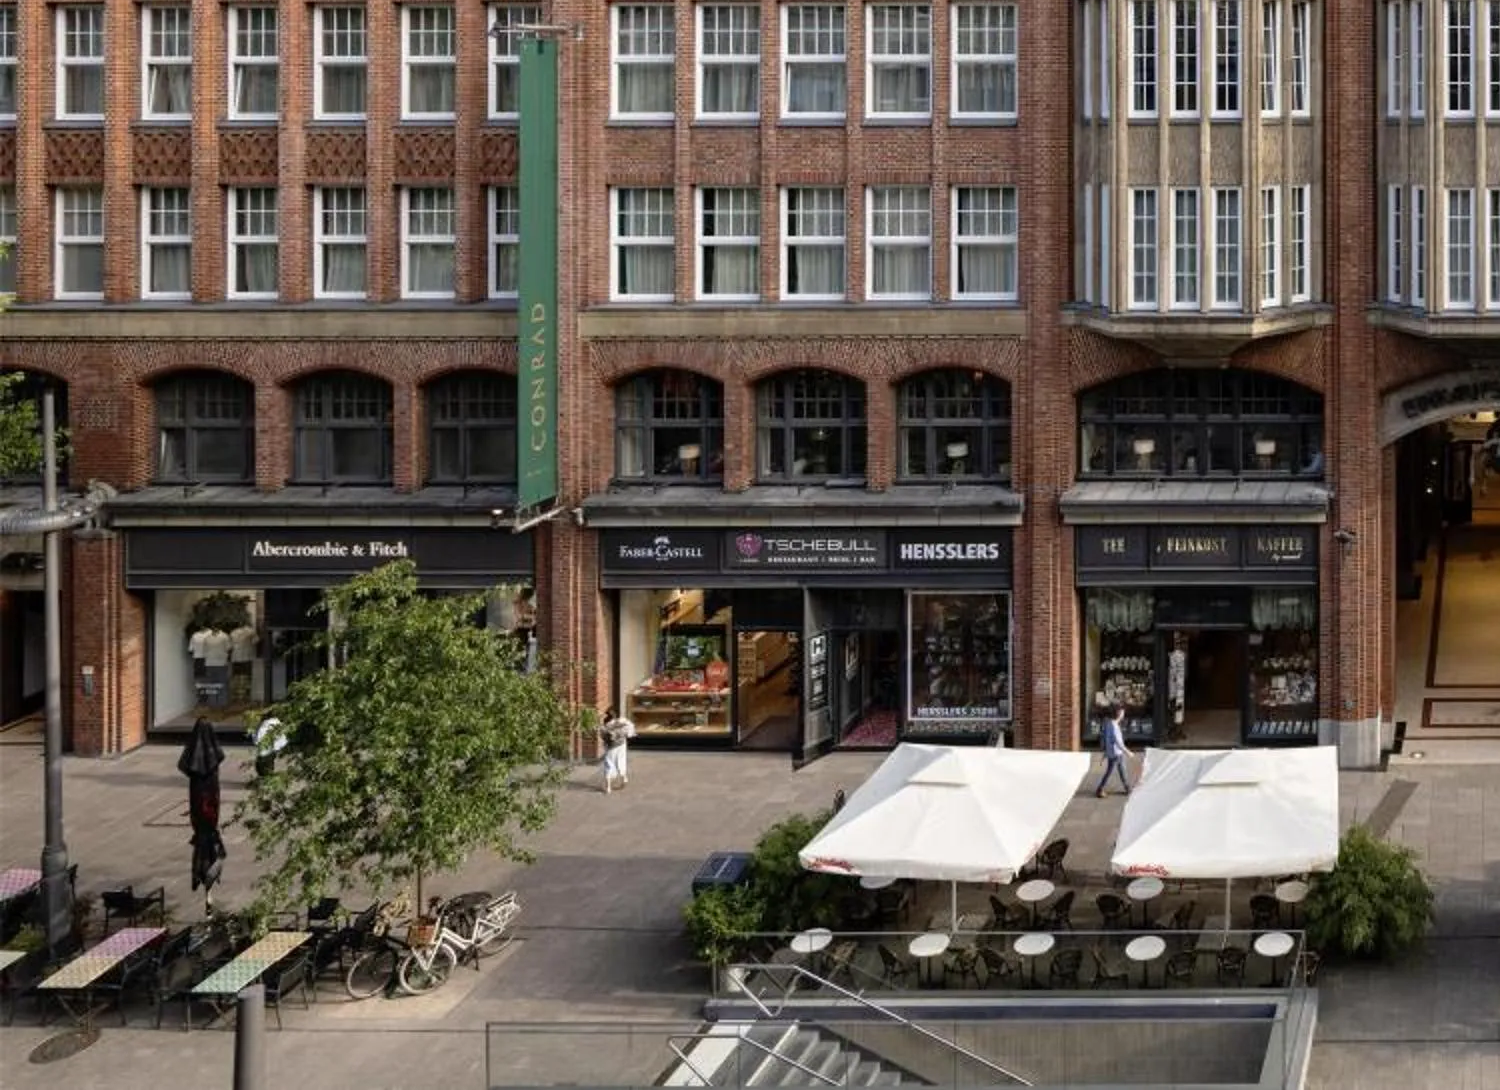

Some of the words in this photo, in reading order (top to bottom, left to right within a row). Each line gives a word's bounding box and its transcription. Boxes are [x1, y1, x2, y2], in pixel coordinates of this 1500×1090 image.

[531, 303, 546, 451] CONRAD
[253, 540, 348, 557] Abercrombie
[351, 542, 365, 556] &
[369, 541, 408, 557] Fitch
[763, 538, 877, 551] TSCHEBULL
[900, 543, 999, 559] HENSSLERS
[1102, 537, 1126, 552] TEE
